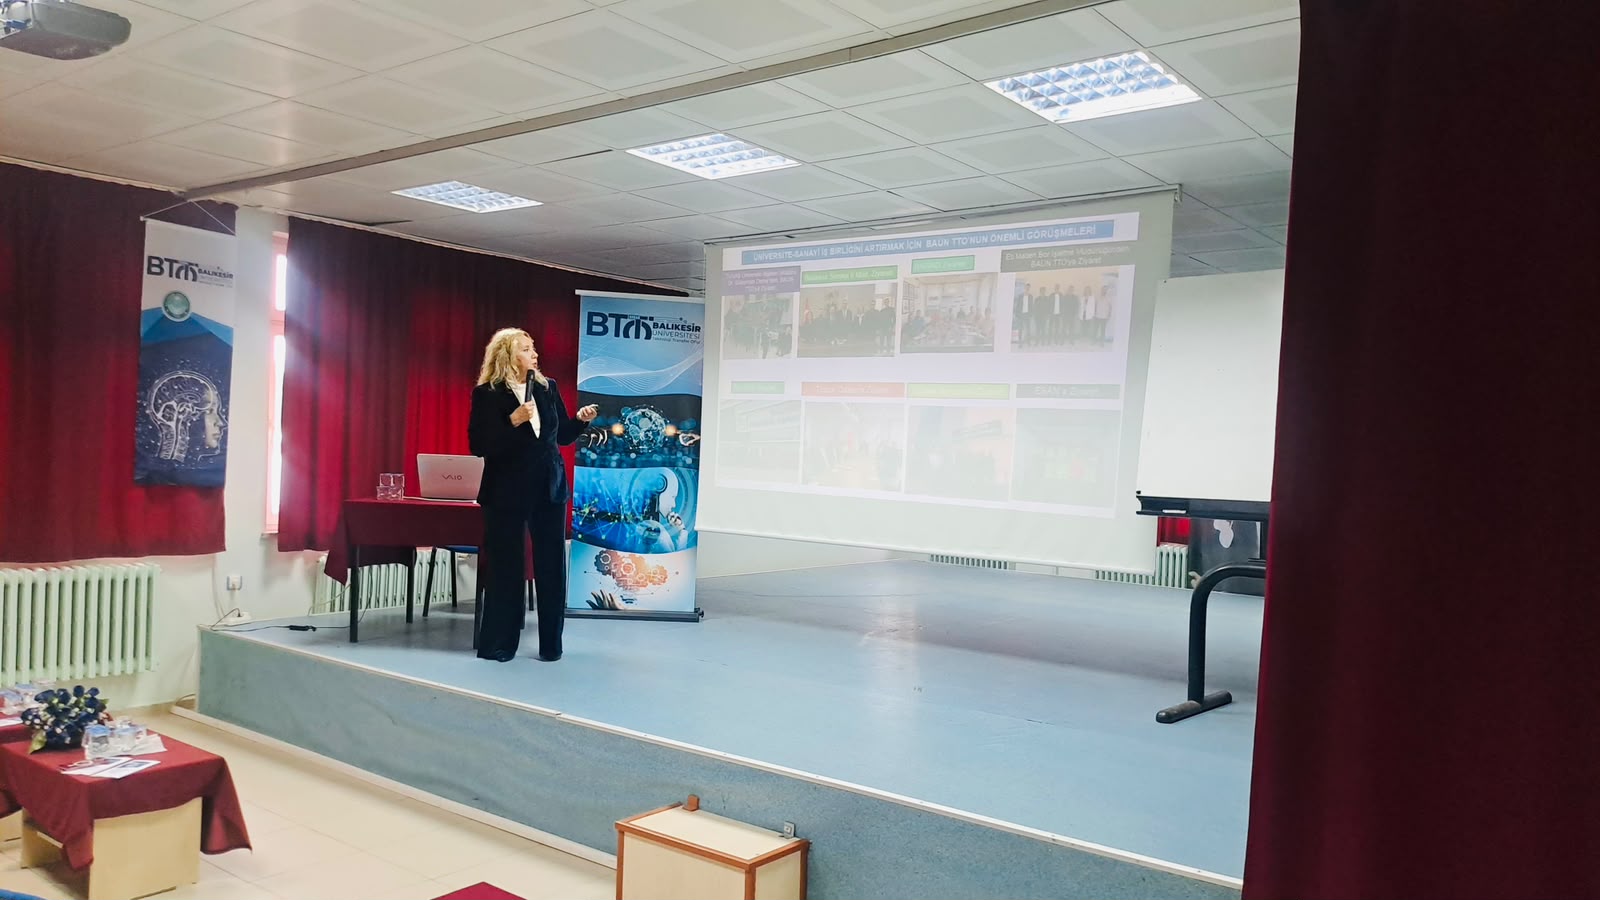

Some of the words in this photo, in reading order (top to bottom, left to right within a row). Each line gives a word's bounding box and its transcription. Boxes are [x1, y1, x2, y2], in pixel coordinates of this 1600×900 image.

[864, 241, 905, 253] ARTIRMAK
[907, 239, 922, 250] İÇİN
[990, 231, 1025, 243] ÖNEMLİ
[652, 322, 701, 333] BALIKESİR
